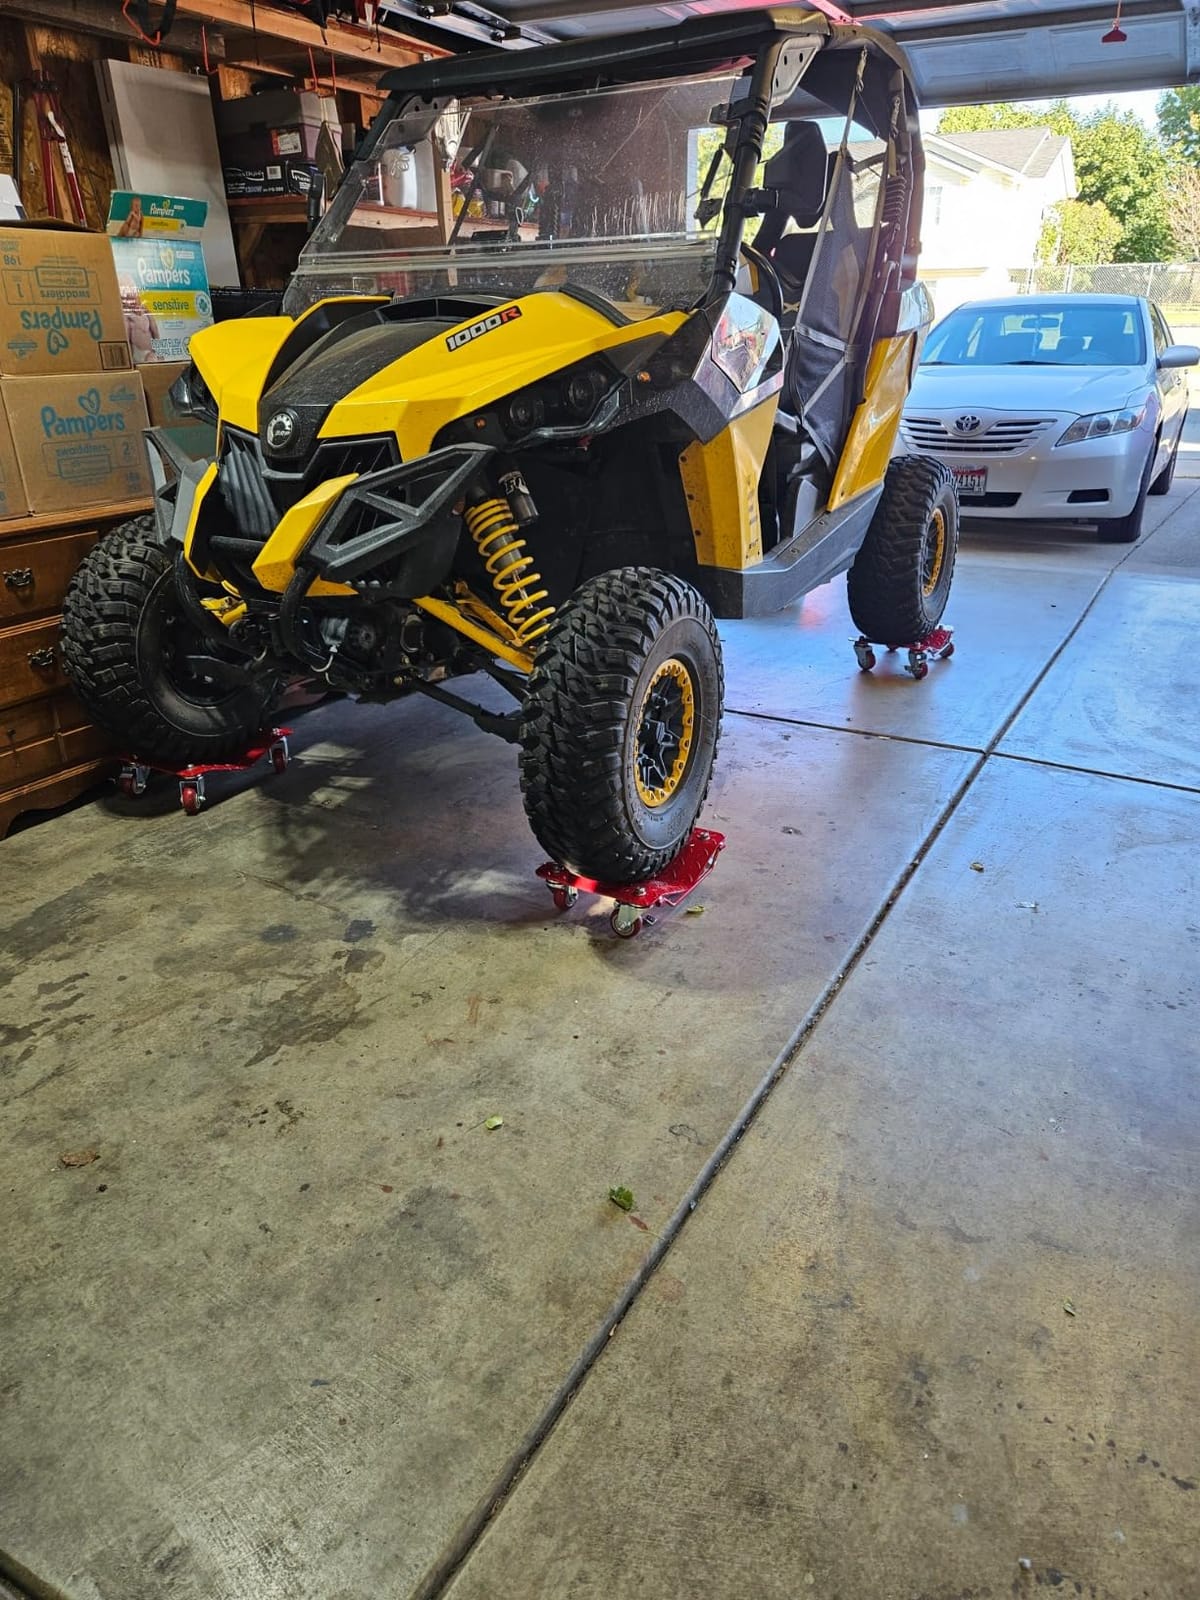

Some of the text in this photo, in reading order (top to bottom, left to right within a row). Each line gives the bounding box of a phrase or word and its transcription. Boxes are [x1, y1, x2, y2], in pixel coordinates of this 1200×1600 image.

[137, 256, 191, 288] Pampers
[40, 288, 91, 299] swaddlers
[152, 299, 190, 310] sensitive
[20, 306, 103, 341] Pampers
[447, 306, 521, 350] 1000R
[40, 405, 125, 438] Pampers
